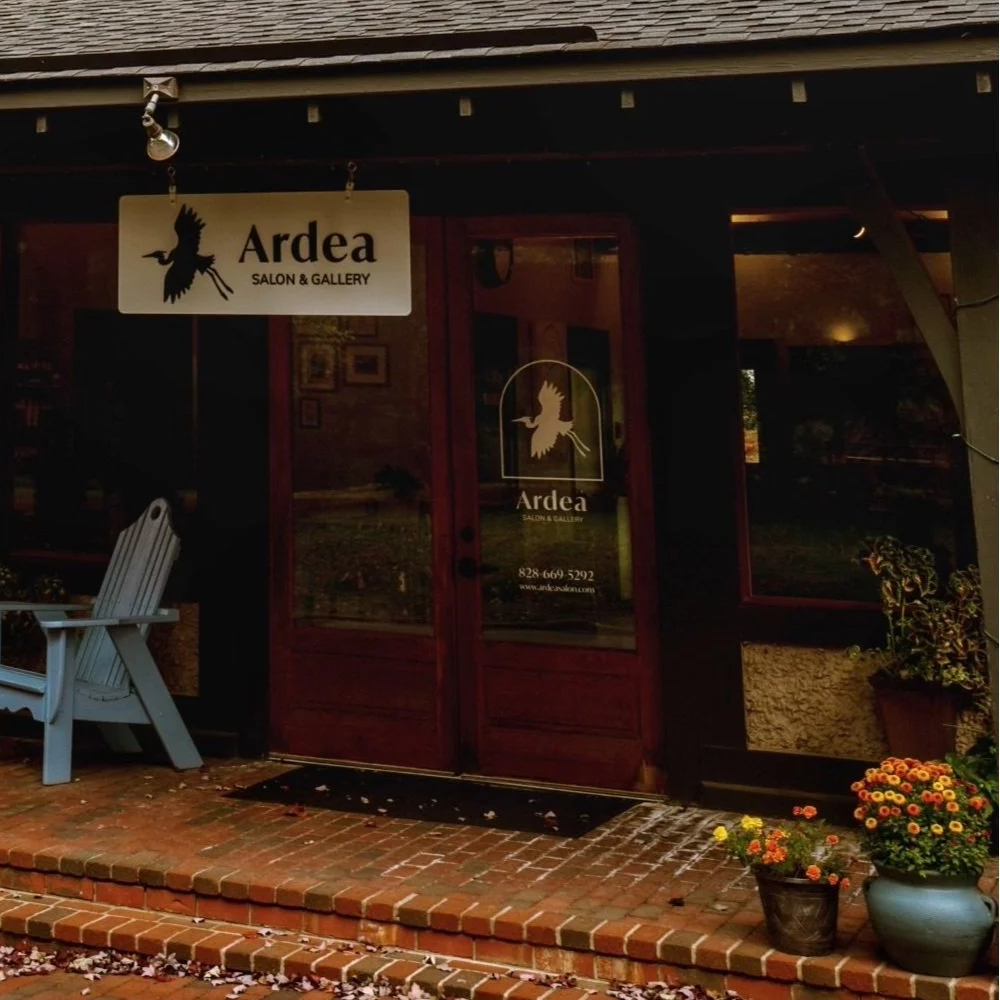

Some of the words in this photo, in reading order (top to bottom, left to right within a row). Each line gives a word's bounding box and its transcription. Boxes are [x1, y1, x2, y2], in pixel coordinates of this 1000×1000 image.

[238, 220, 377, 264] Ardea
[252, 273, 295, 285] SALON
[299, 273, 308, 285] &
[311, 273, 370, 285] GALLERY
[516, 490, 588, 512] Ardea
